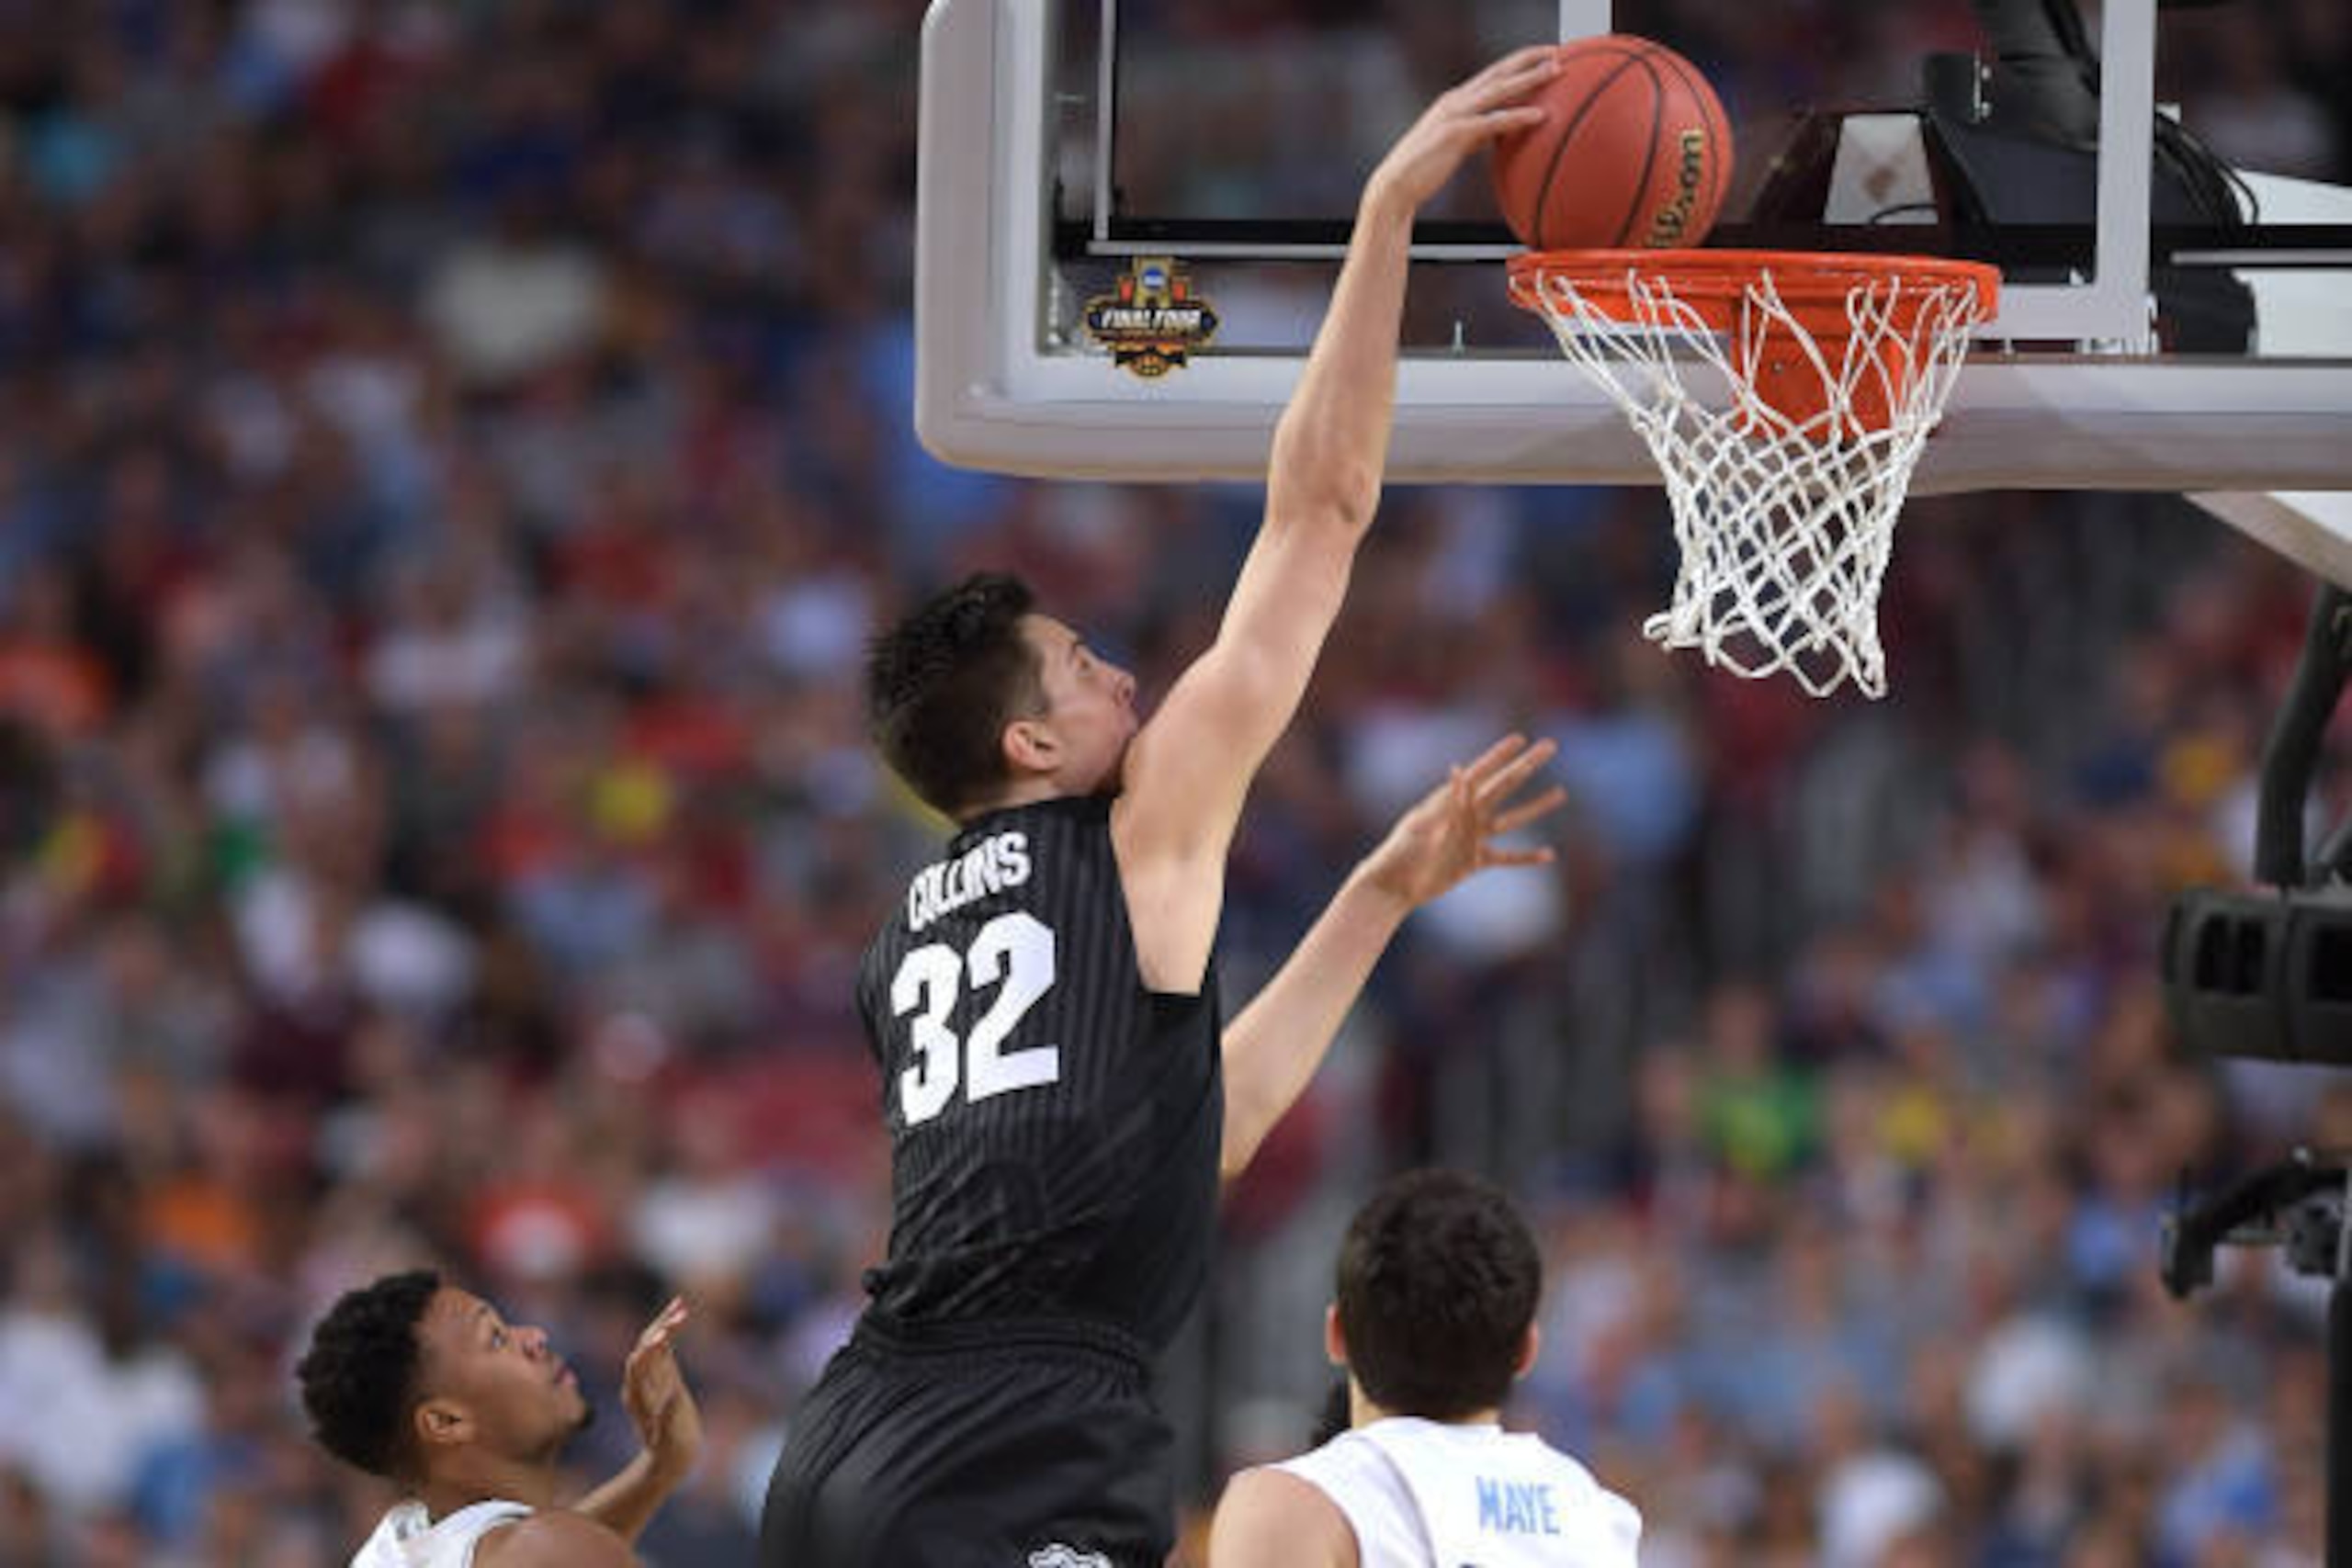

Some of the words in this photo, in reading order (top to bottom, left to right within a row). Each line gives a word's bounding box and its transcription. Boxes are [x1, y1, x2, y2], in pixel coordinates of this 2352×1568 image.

[1644, 128, 1704, 248] ilson
[908, 830, 1033, 933] COLLINS
[889, 911, 1059, 1127] 32
[1476, 1474, 1561, 1536] MAYE
